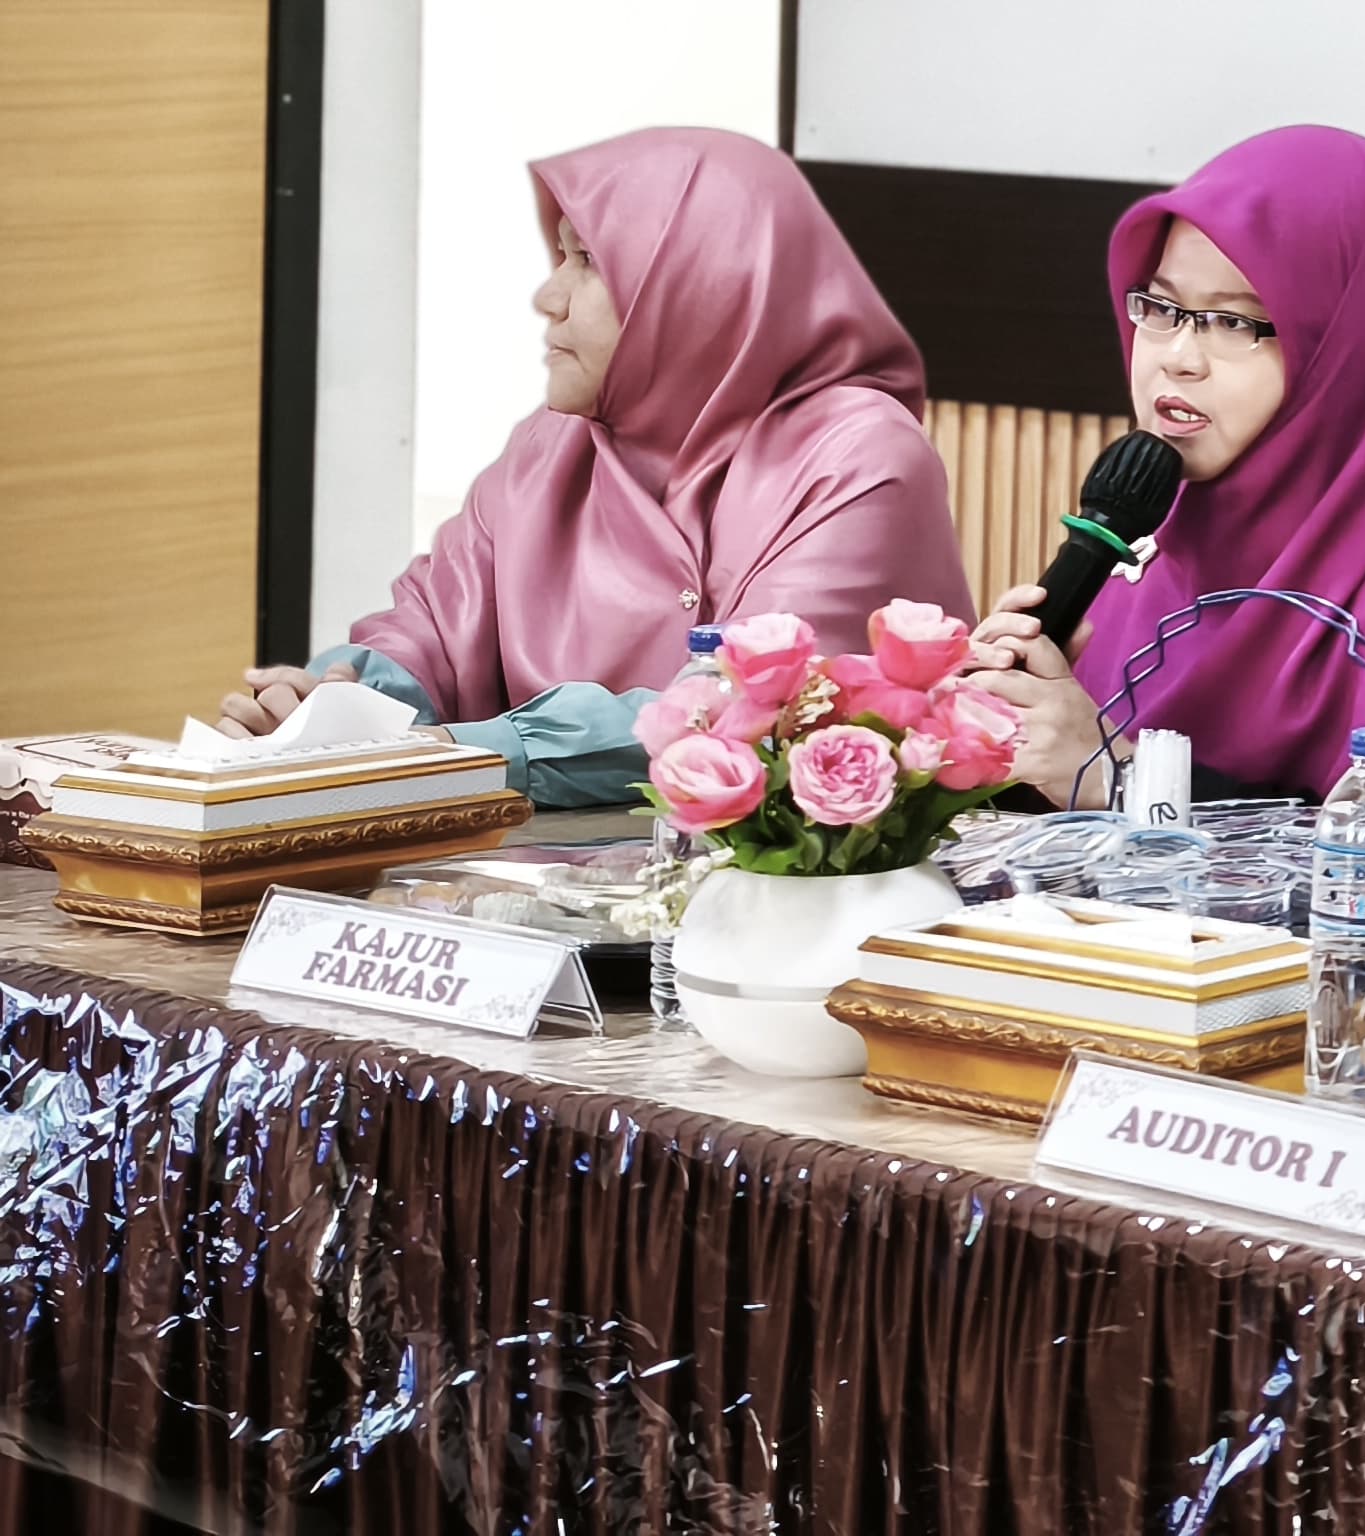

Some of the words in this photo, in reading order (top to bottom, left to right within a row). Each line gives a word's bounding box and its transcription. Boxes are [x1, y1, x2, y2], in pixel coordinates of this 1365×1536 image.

[332, 921, 461, 971] KAJUR
[302, 951, 471, 1006] FARMASI
[1107, 1105, 1314, 1183] AUDITOR
[1317, 1150, 1347, 1188] I
